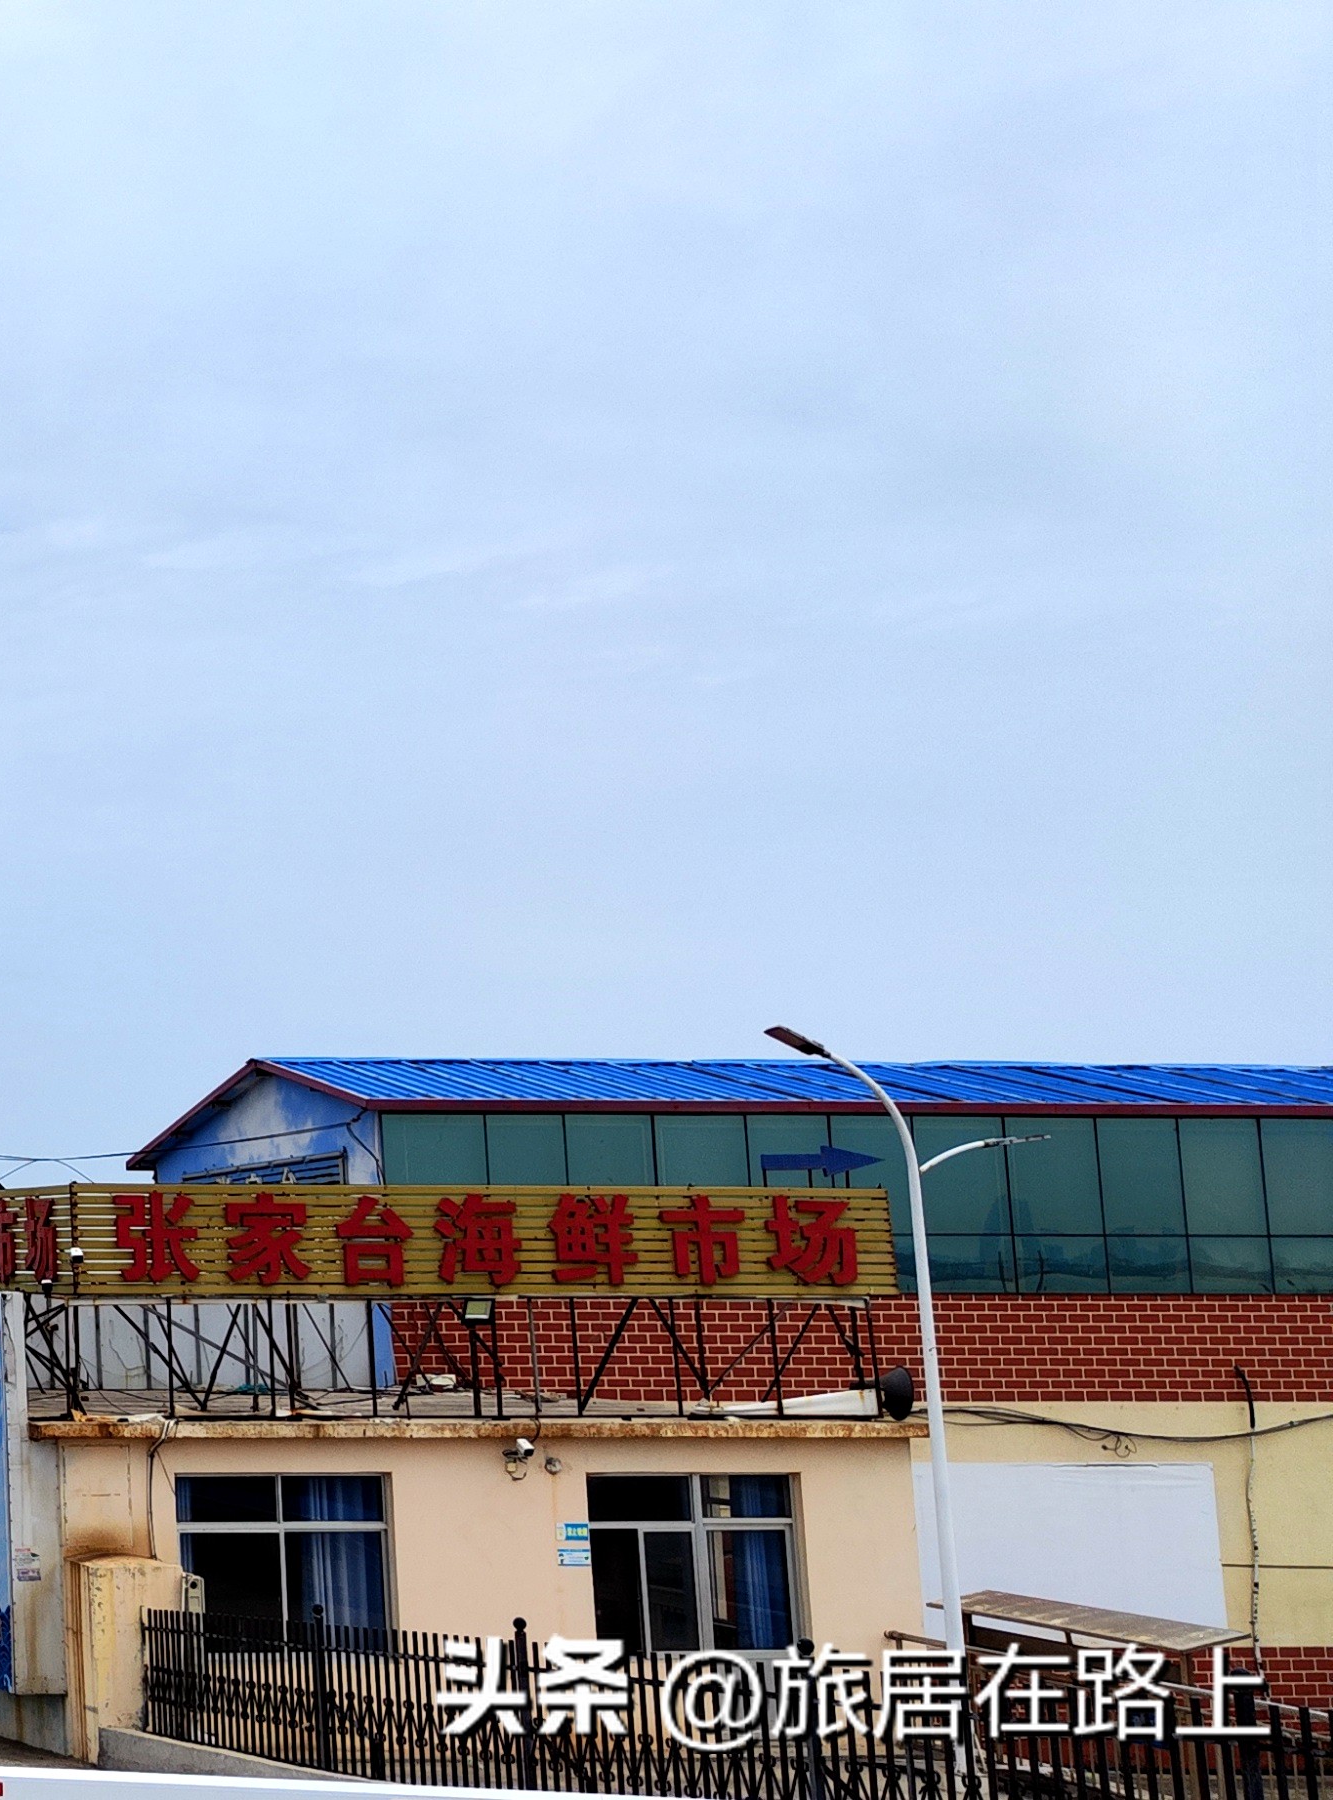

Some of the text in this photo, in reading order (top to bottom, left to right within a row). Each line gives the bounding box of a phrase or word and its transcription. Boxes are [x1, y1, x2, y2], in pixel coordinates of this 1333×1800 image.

[114, 1191, 859, 1287] 张家台海鲜市场
